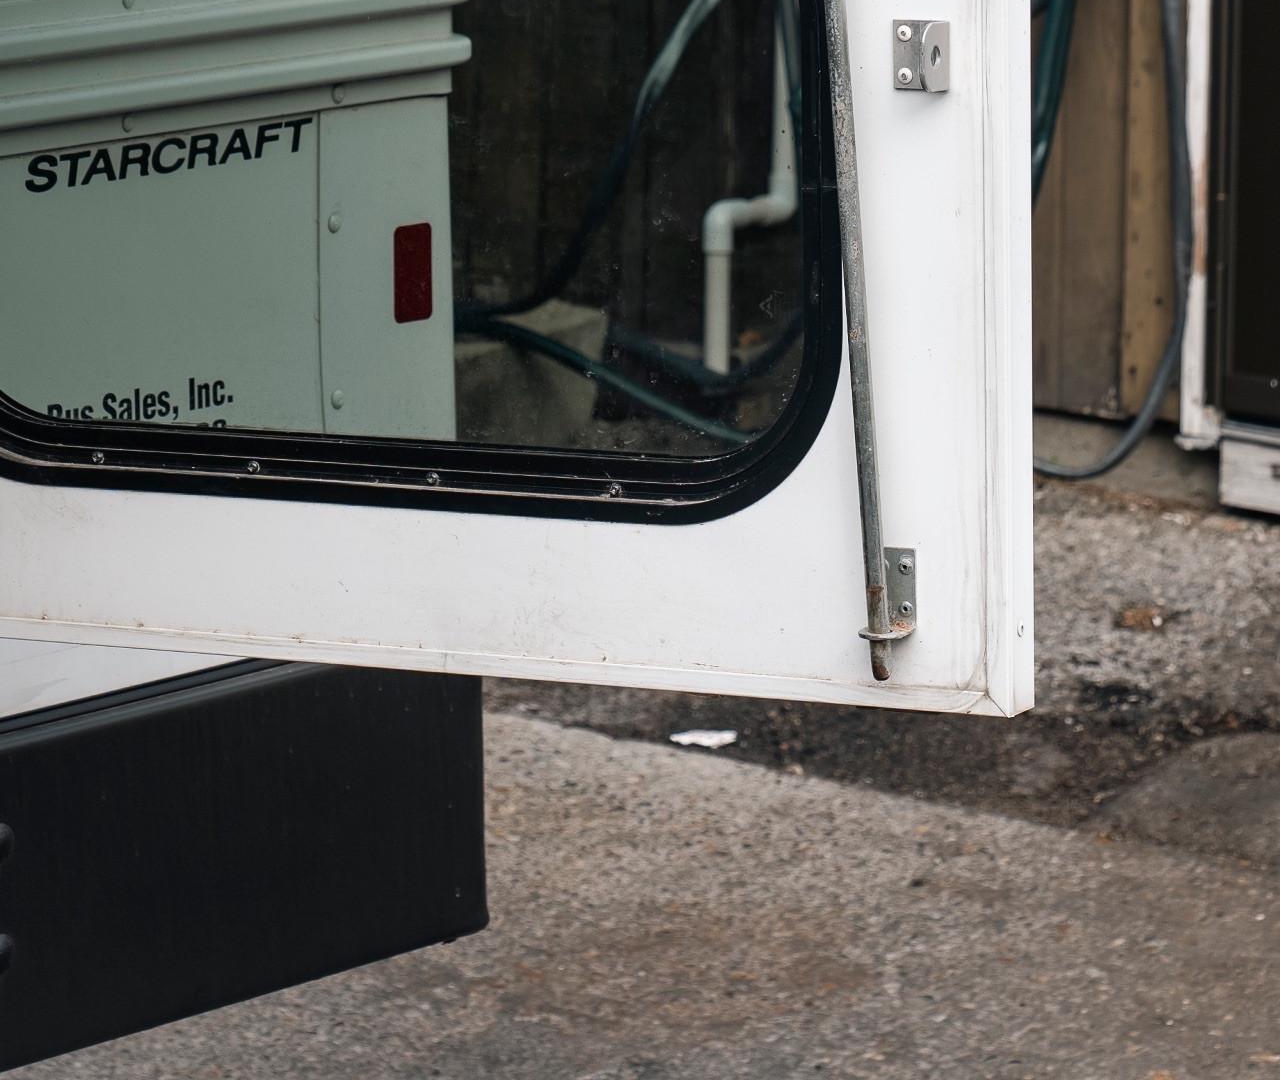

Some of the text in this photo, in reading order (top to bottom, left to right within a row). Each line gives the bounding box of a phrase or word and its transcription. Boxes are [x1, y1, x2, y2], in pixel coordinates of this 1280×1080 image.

[24, 117, 314, 193] STARCRAFT
[102, 388, 179, 421] Sales,
[188, 377, 234, 411] Inc.
